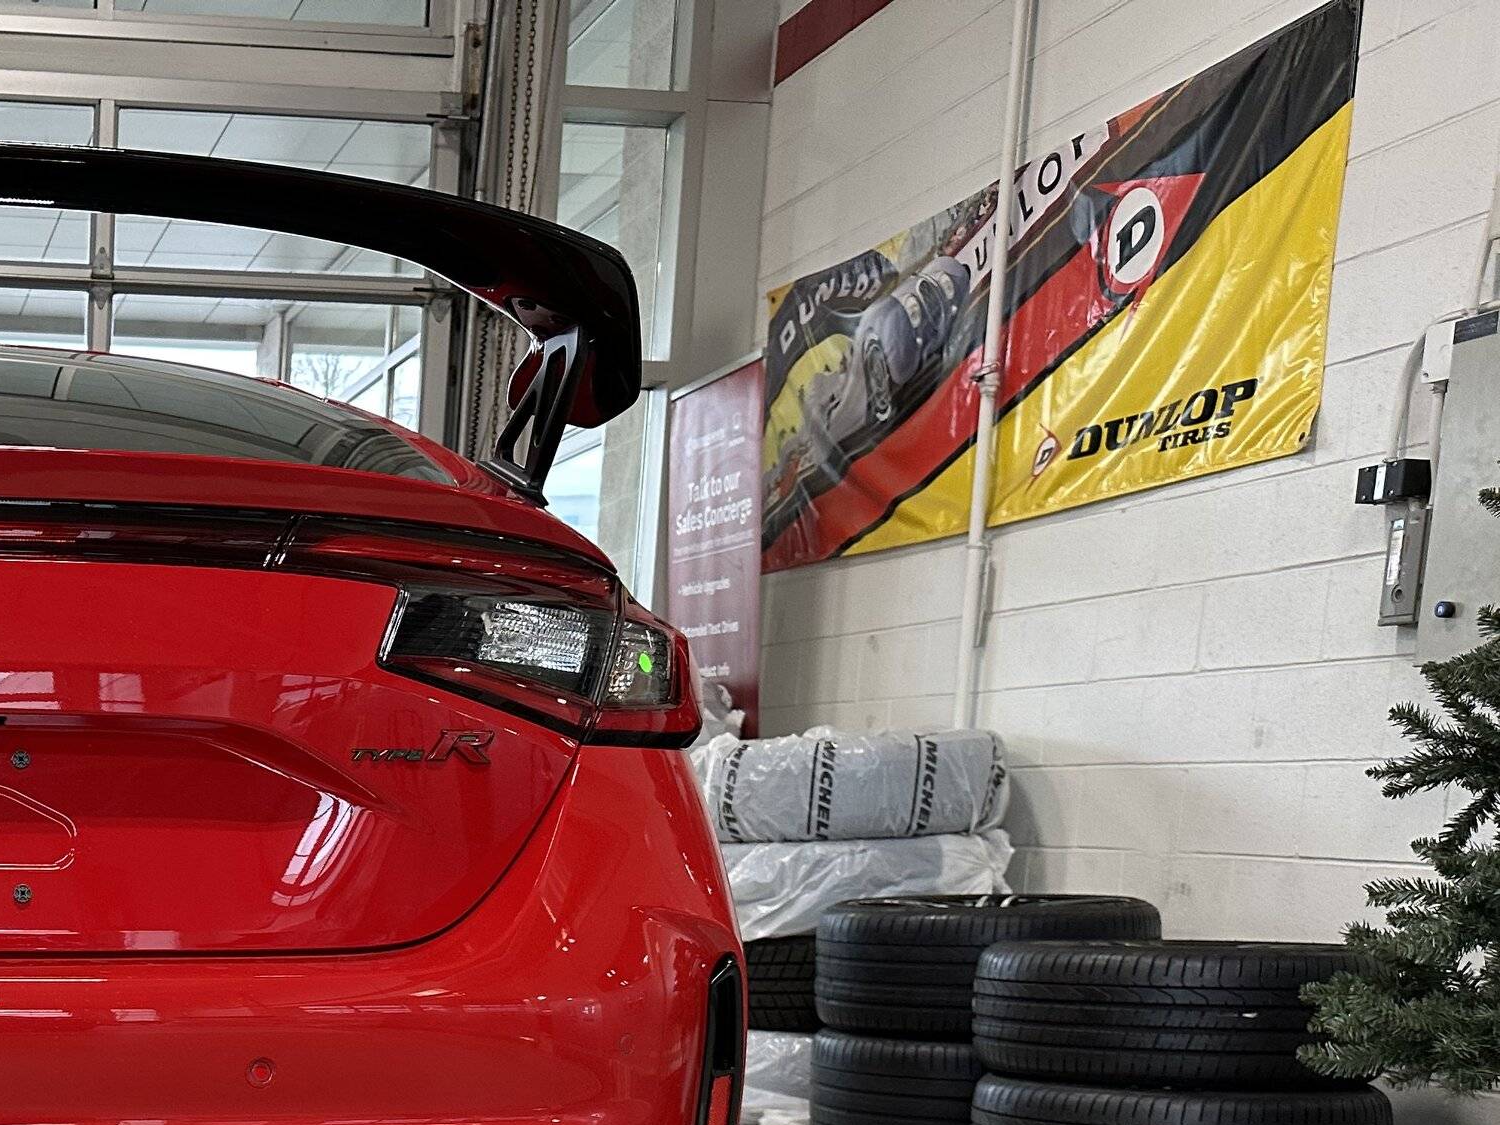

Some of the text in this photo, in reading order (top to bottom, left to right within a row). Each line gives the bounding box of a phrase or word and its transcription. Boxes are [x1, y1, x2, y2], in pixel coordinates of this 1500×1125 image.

[1115, 205, 1156, 273] D
[1066, 378, 1259, 460] DUNLOP
[1157, 421, 1231, 452] TIRES
[688, 471, 741, 502] Talk to our
[676, 496, 752, 535] Sales Concierge
[351, 729, 495, 764] TYPE R
